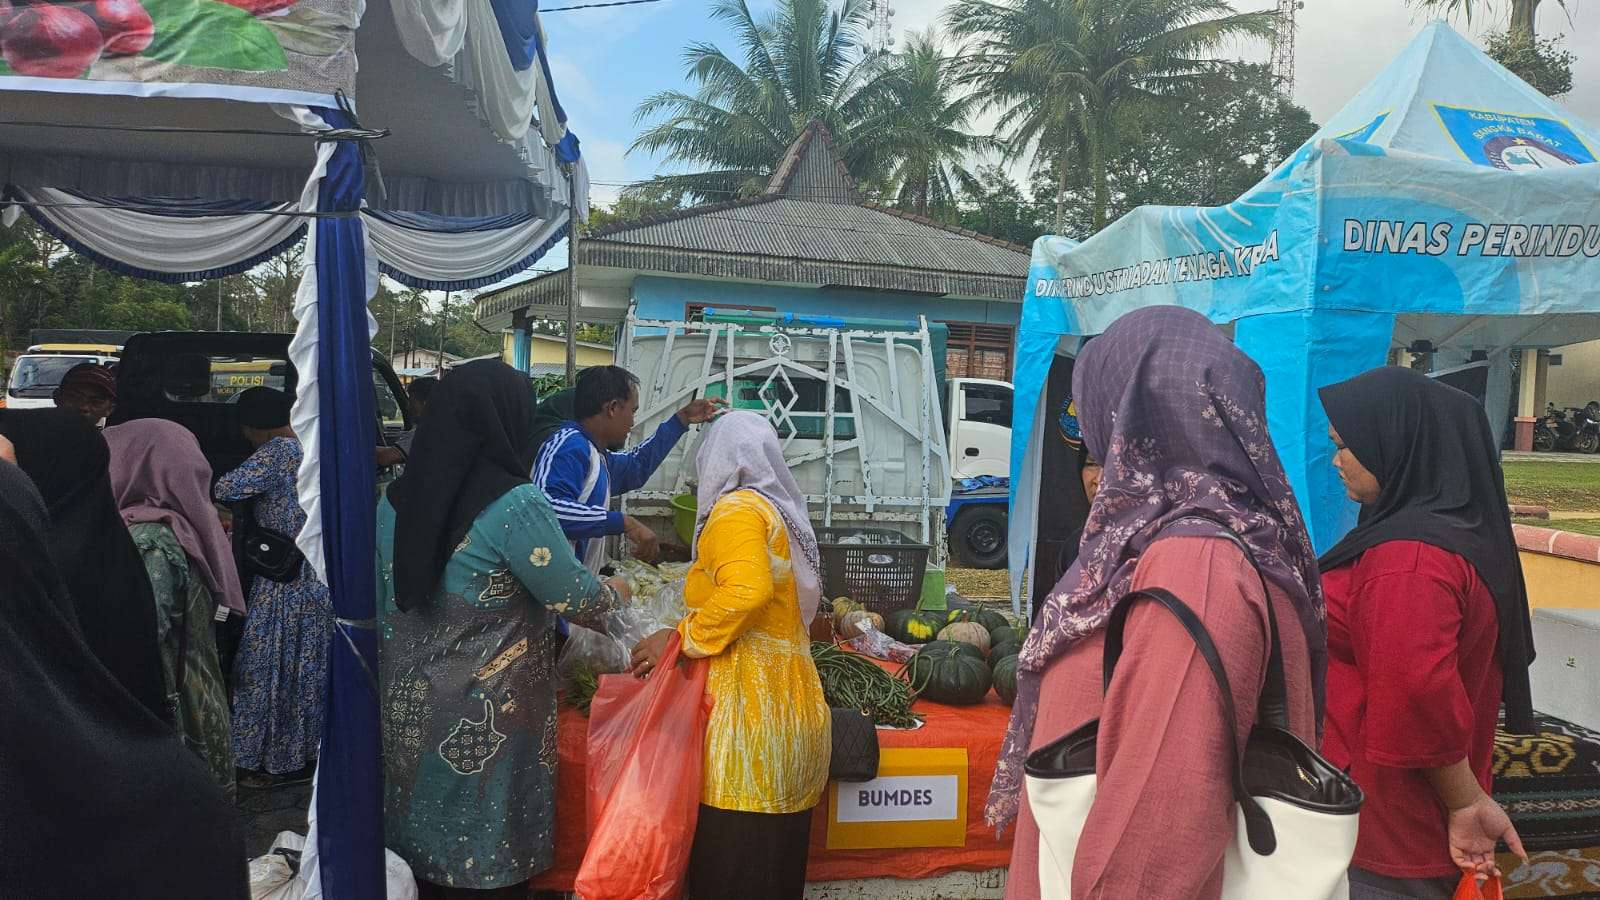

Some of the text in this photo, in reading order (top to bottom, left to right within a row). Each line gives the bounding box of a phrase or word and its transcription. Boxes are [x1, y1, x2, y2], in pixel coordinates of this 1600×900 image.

[1468, 111, 1536, 126] KABUPATEN
[1472, 124, 1562, 147] BANGKA BARAT
[1344, 219, 1453, 255] DINAS
[1173, 250, 1234, 283] TENAGA
[230, 375, 265, 386] POLISI
[858, 789, 933, 807] BUMDES
